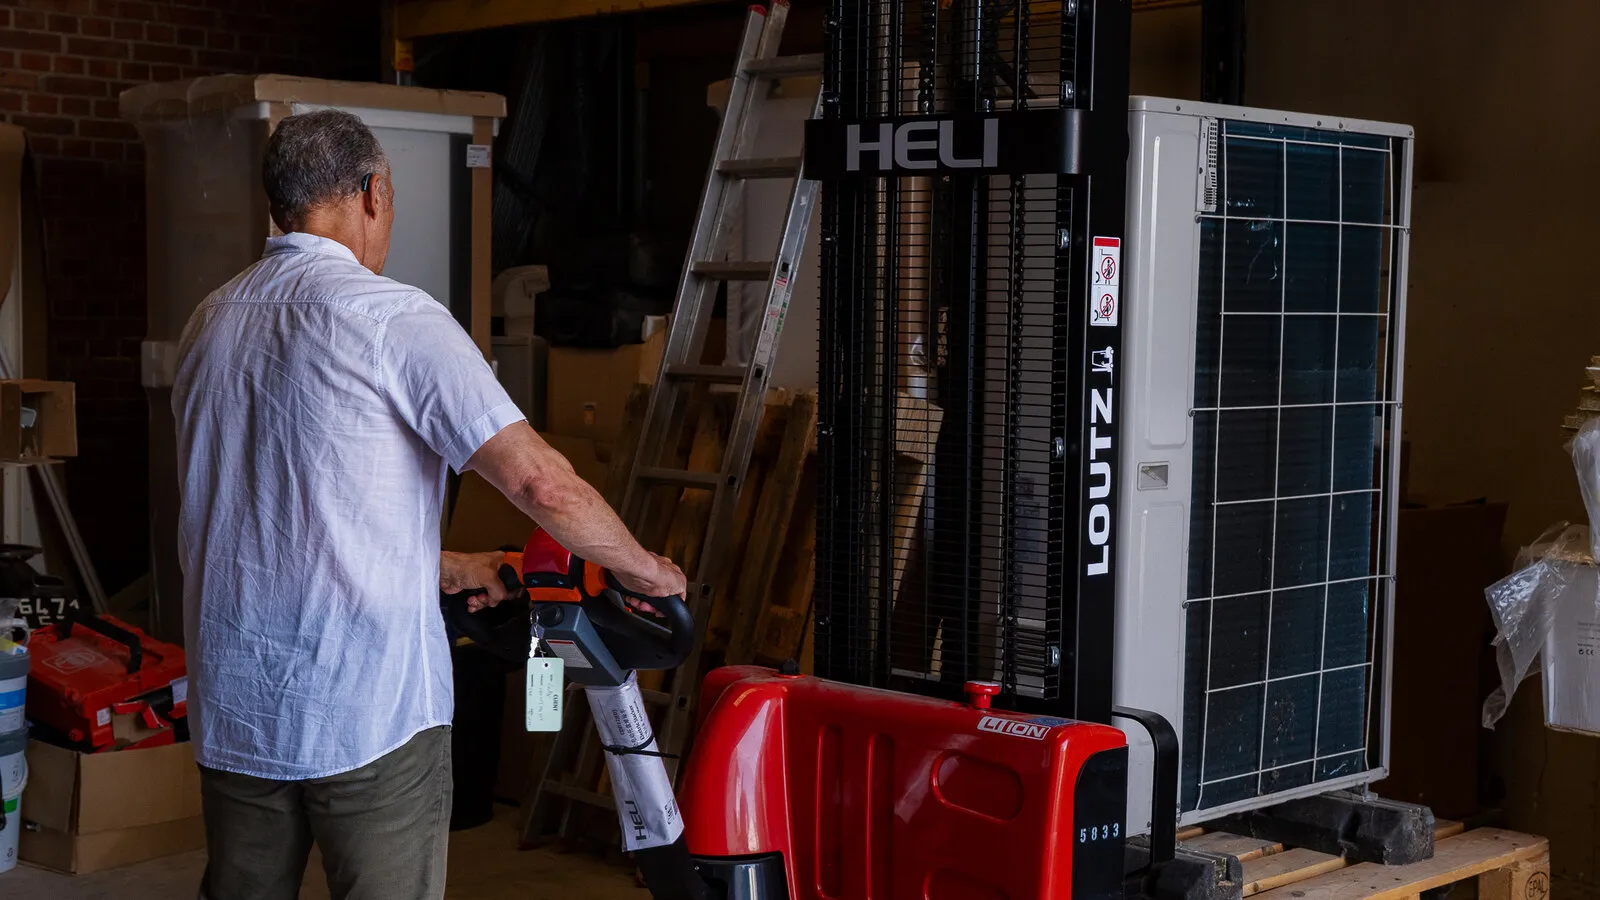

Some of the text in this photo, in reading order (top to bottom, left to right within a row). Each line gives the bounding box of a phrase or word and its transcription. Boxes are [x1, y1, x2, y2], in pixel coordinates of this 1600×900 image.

[846, 118, 999, 171] HELI
[1087, 388, 1113, 576] LOUTZ
[1006, 722, 1045, 738] ION
[625, 800, 647, 841] HELI
[1080, 822, 1119, 843] 5833
